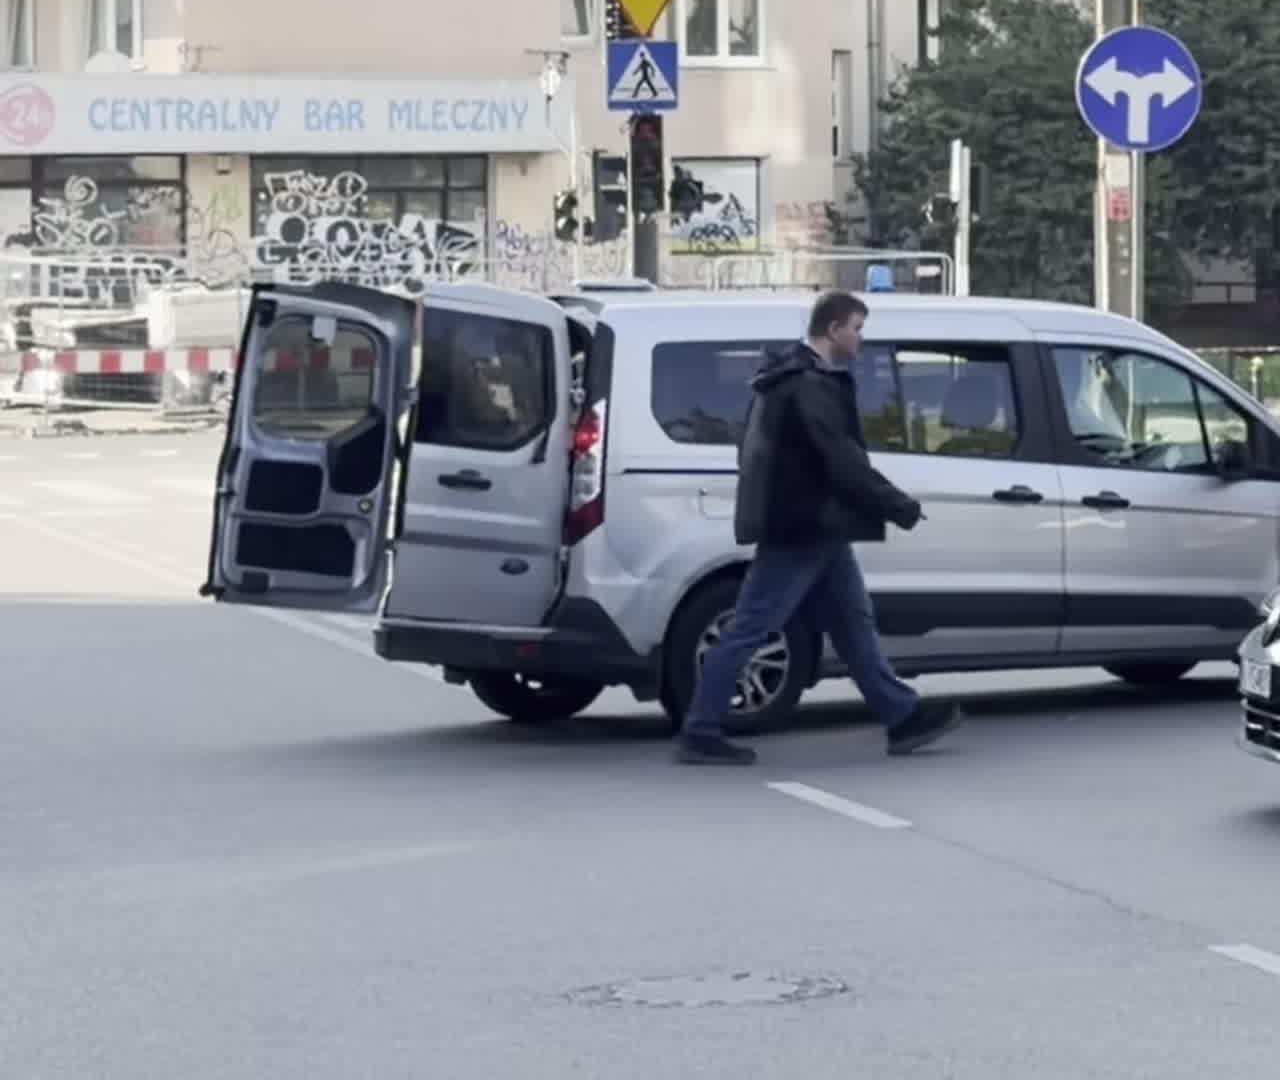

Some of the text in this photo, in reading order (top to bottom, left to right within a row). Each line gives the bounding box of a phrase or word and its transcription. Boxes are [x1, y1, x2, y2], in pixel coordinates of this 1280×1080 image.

[88, 96, 529, 133] CENTRALNY BAR MLECZNY
